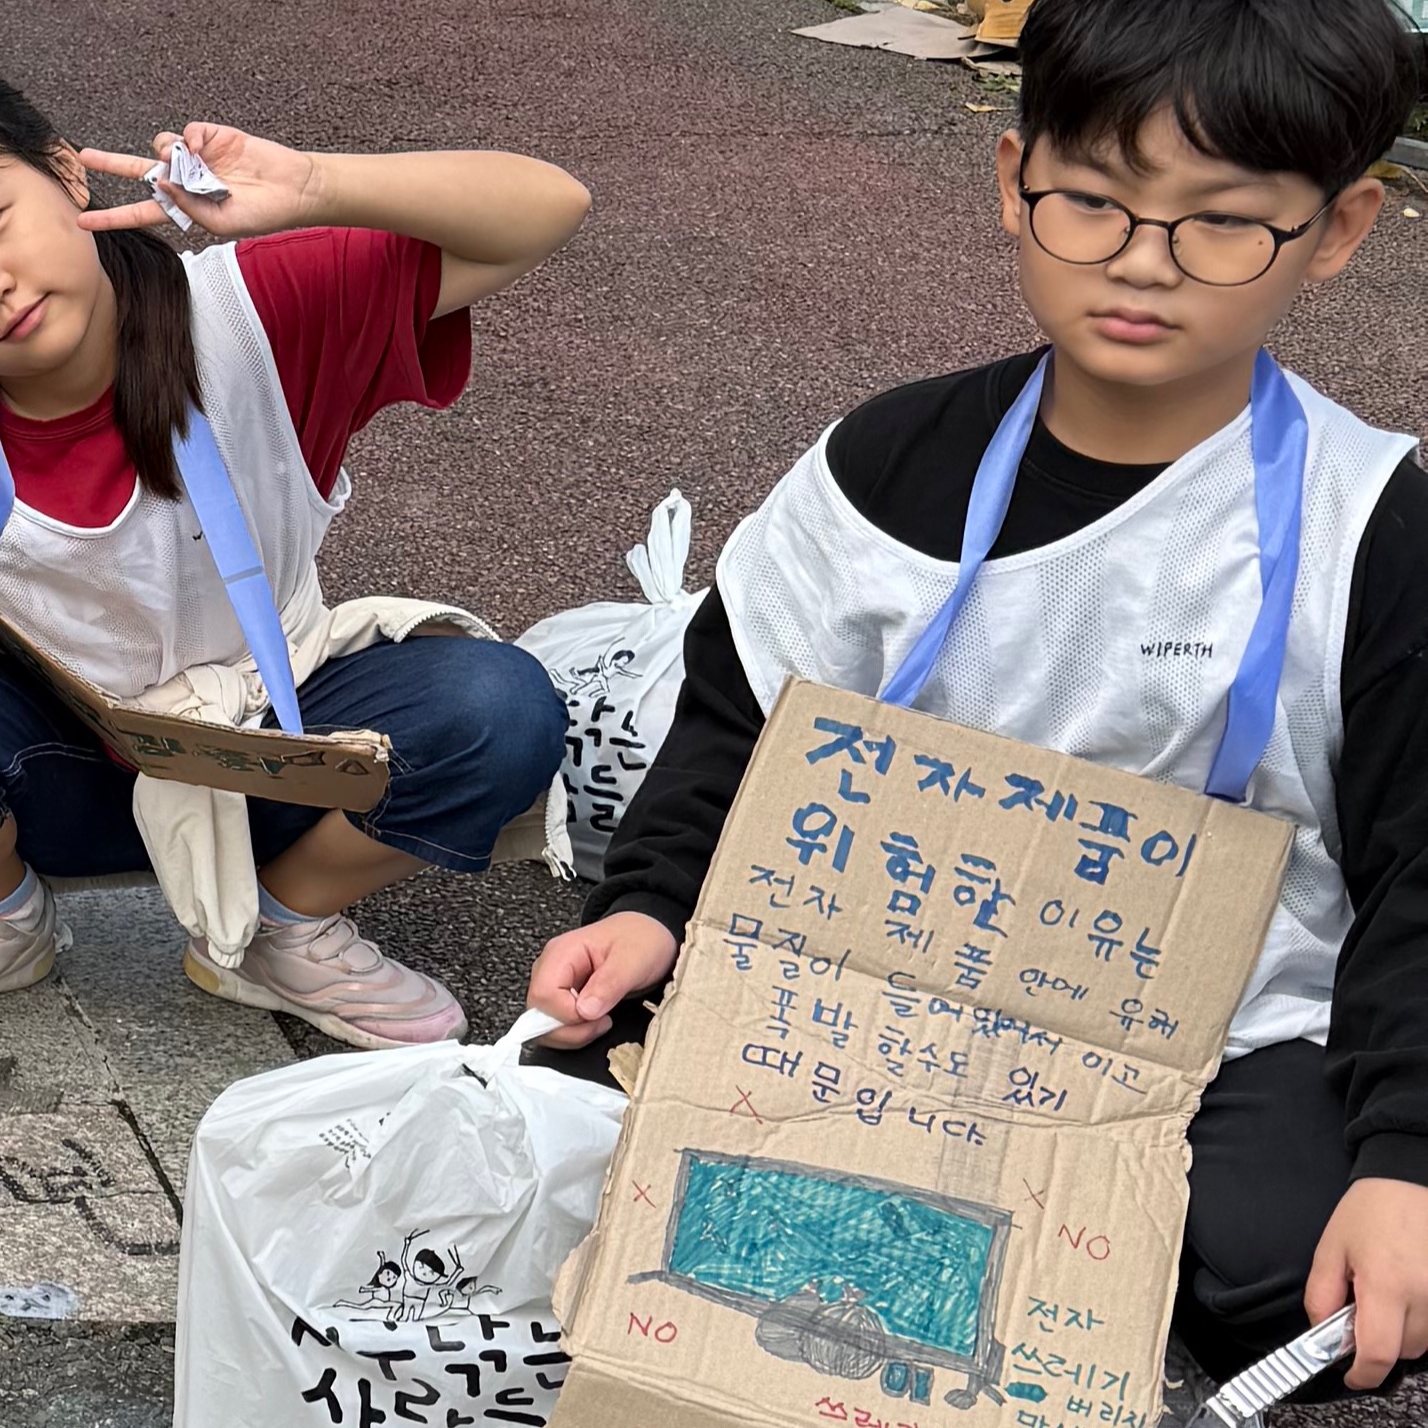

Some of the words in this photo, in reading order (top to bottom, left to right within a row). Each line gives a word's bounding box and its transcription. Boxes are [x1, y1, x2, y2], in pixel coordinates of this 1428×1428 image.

[1139, 640, 1214, 660] WIPERTH
[804, 715, 1197, 885] 전자제품이
[785, 801, 1016, 938] 위험한
[1038, 897, 1164, 981] 이유는
[721, 912, 847, 983] 물질이
[1020, 966, 1089, 1003] 안에
[1007, 1064, 1068, 1114] 있기
[1057, 1222, 1113, 1262] NO
[628, 1311, 678, 1345] NO
[1026, 1293, 1107, 1339] 전자
[1009, 1341, 1133, 1402] 쓰레기
